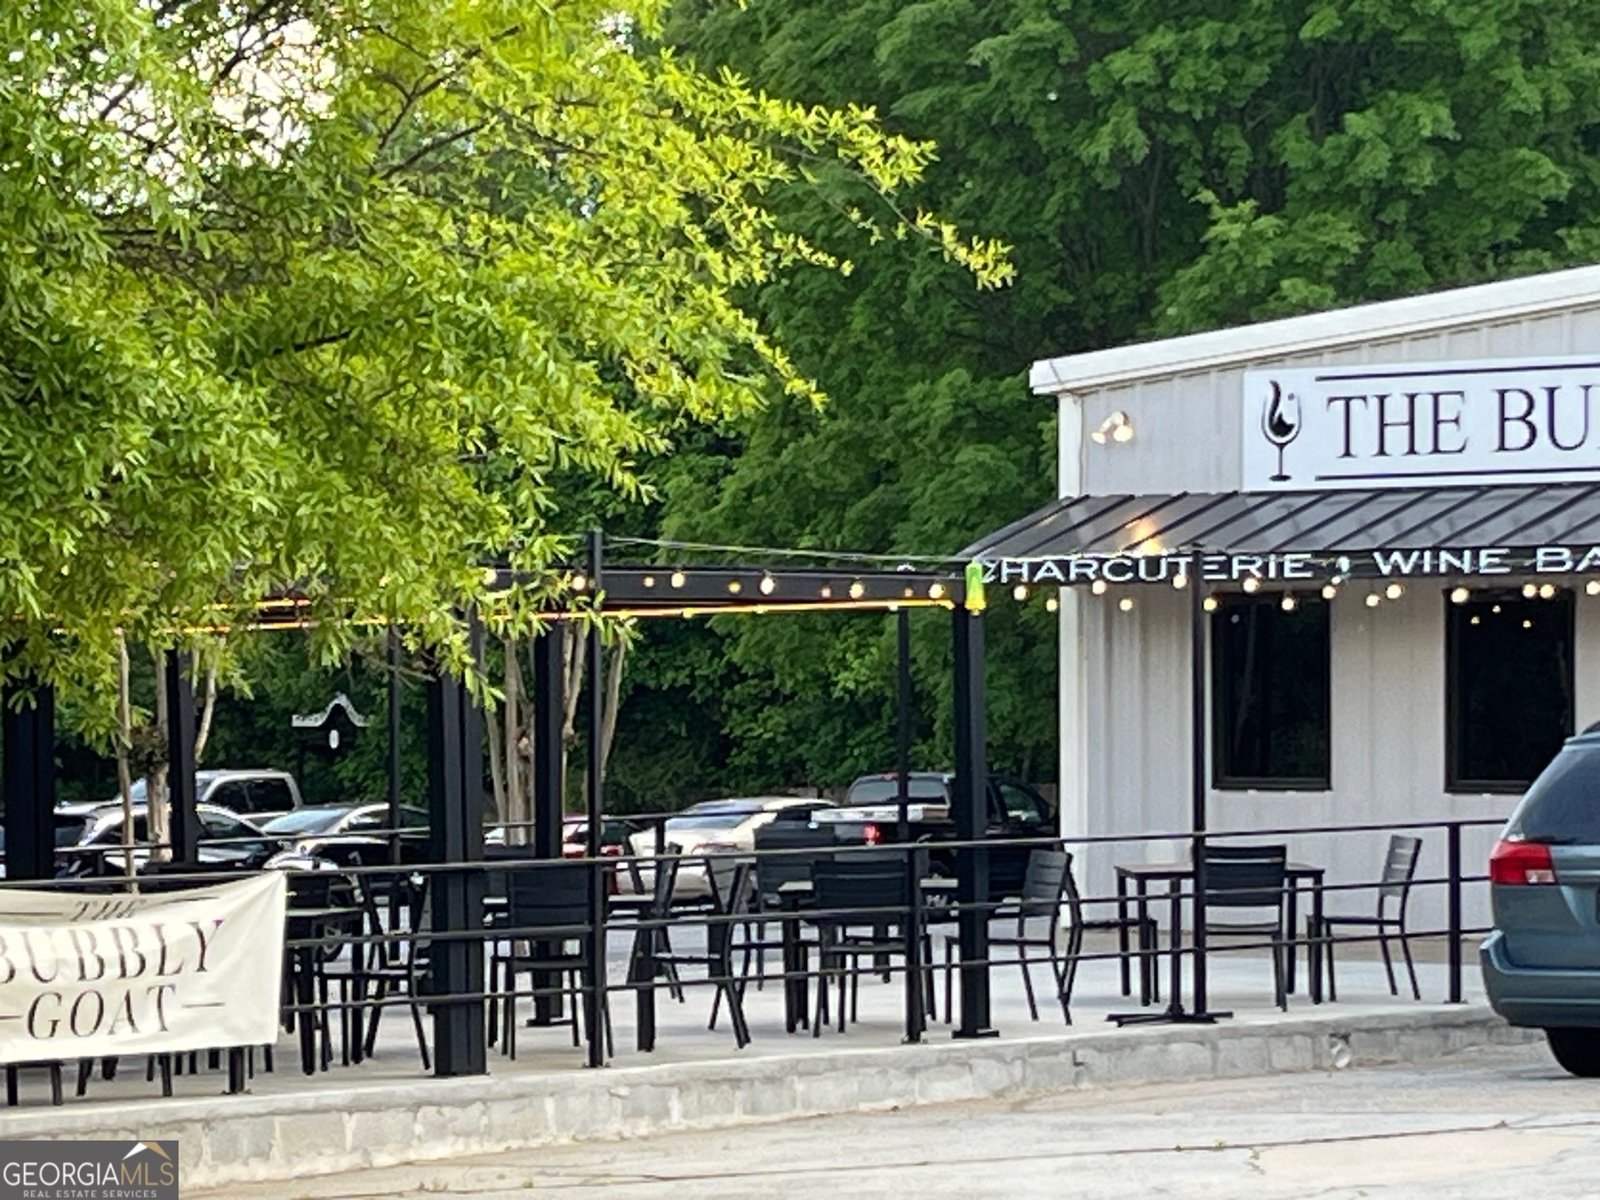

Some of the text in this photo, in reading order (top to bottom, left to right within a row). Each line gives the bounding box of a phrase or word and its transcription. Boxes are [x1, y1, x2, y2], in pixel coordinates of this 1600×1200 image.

[1326, 383, 1600, 459] THE BU
[1372, 549, 1512, 576] WINE
[70, 899, 147, 922] THE
[27, 983, 176, 1040] GOAT
